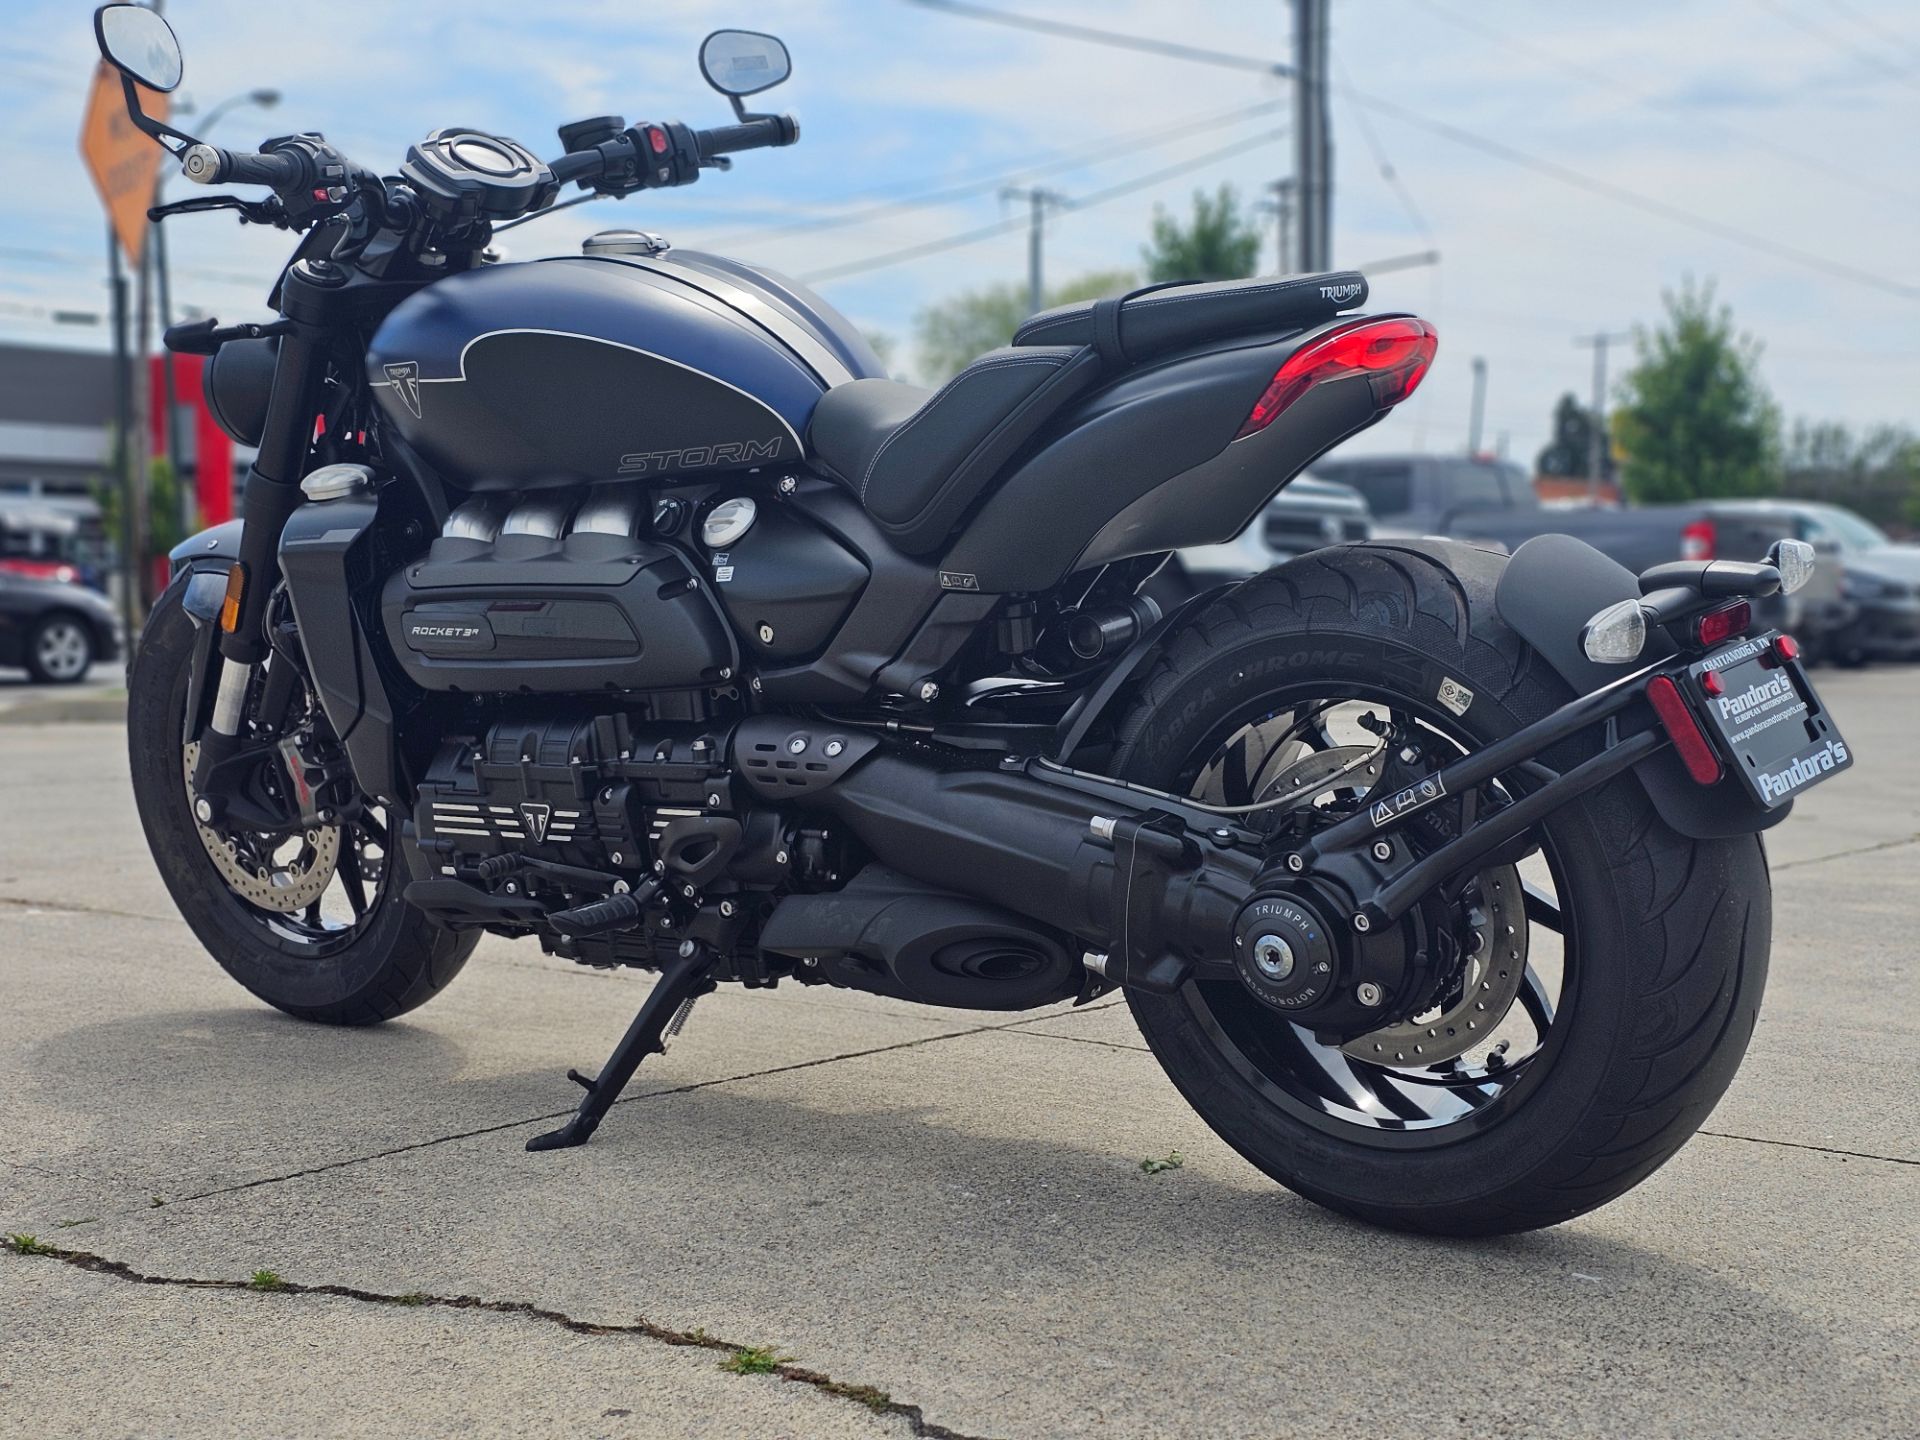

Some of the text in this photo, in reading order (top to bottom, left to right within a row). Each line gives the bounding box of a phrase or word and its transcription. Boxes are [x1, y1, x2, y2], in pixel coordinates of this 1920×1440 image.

[1320, 283, 1361, 303] TRIUMPH
[617, 436, 783, 473] STORM
[1227, 650, 1366, 687] CHROME
[1702, 636, 1771, 672] CHATTANOOGA TN
[1718, 673, 1791, 720] Pandora's
[1734, 691, 1794, 725] EUROPEAN MOTORSPORTS
[1757, 740, 1848, 802] Pandora's
[1256, 904, 1309, 930] TRIUMPH
[1241, 968, 1316, 1005] MOTORCYCLES
